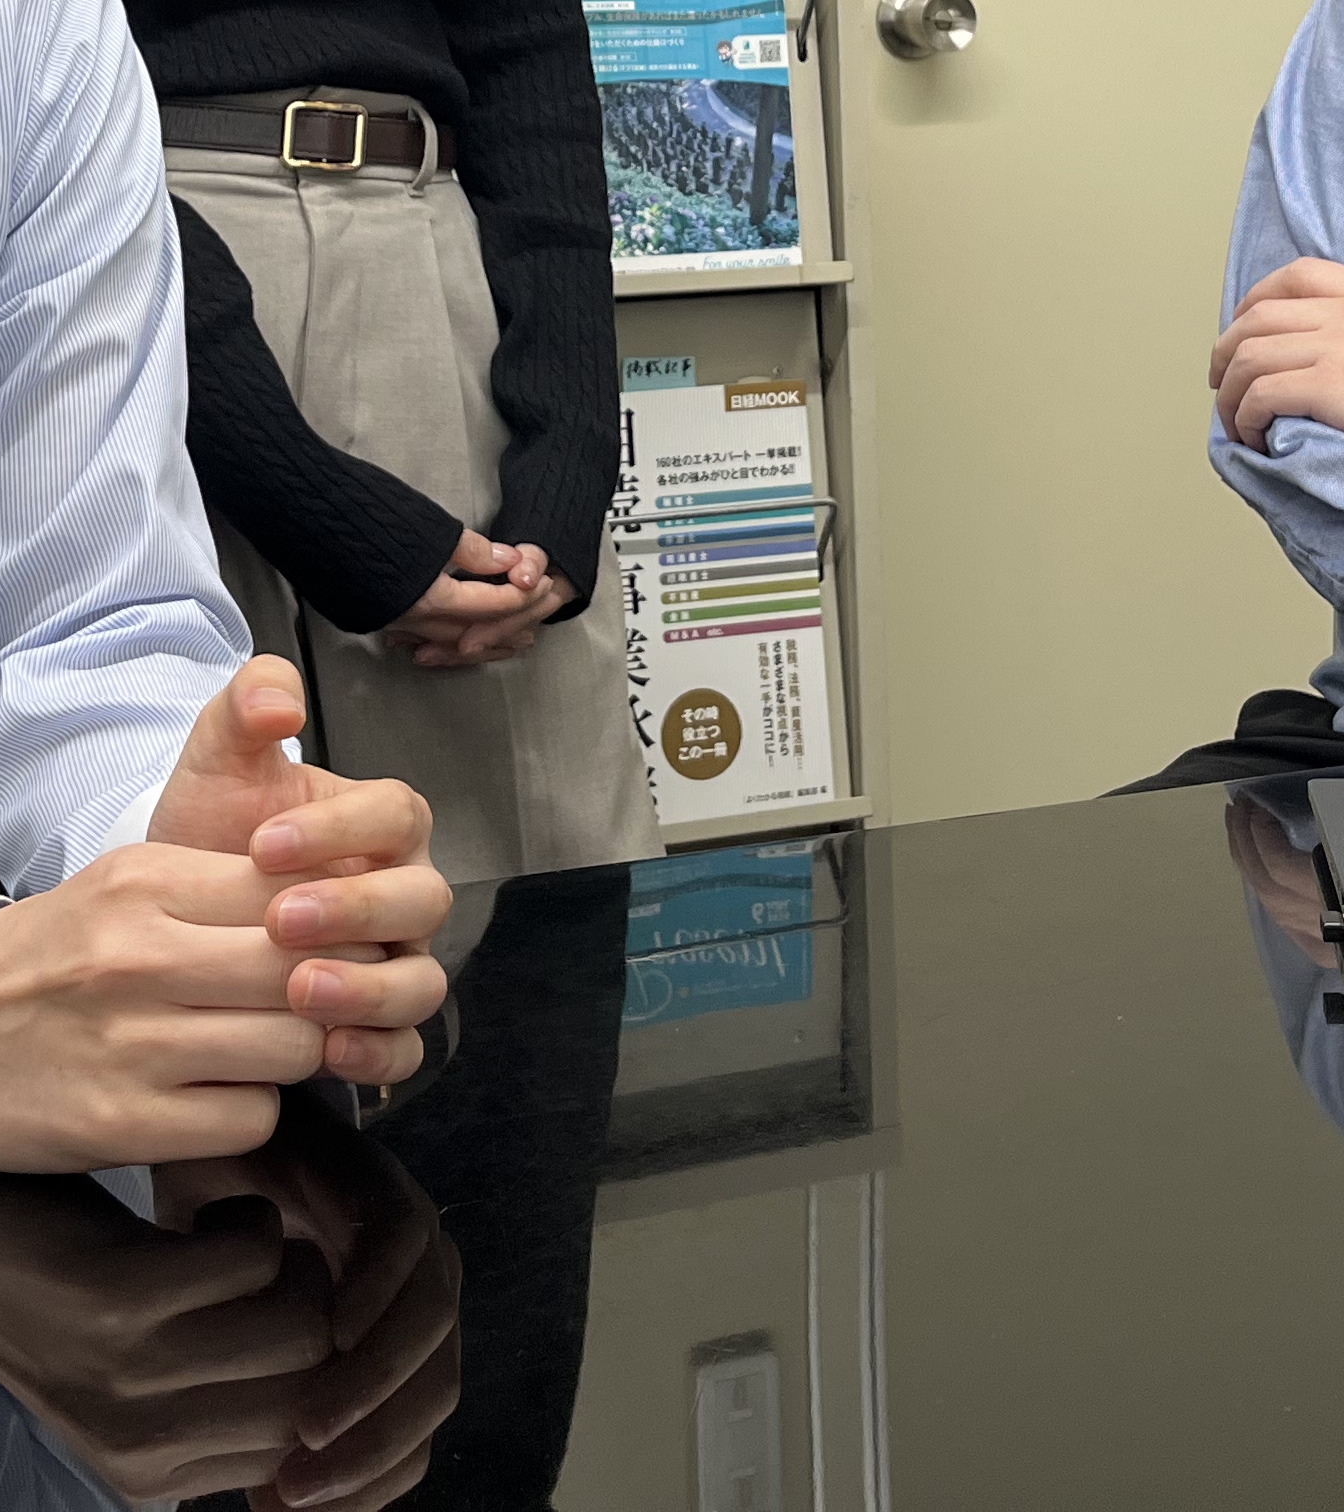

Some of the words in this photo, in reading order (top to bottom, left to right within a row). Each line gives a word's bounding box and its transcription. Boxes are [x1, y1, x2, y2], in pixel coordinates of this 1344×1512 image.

[730, 391, 801, 409] 日経MOOK
[681, 706, 719, 723] その時
[682, 725, 722, 742] 役立つ
[678, 742, 728, 761] この一冊
